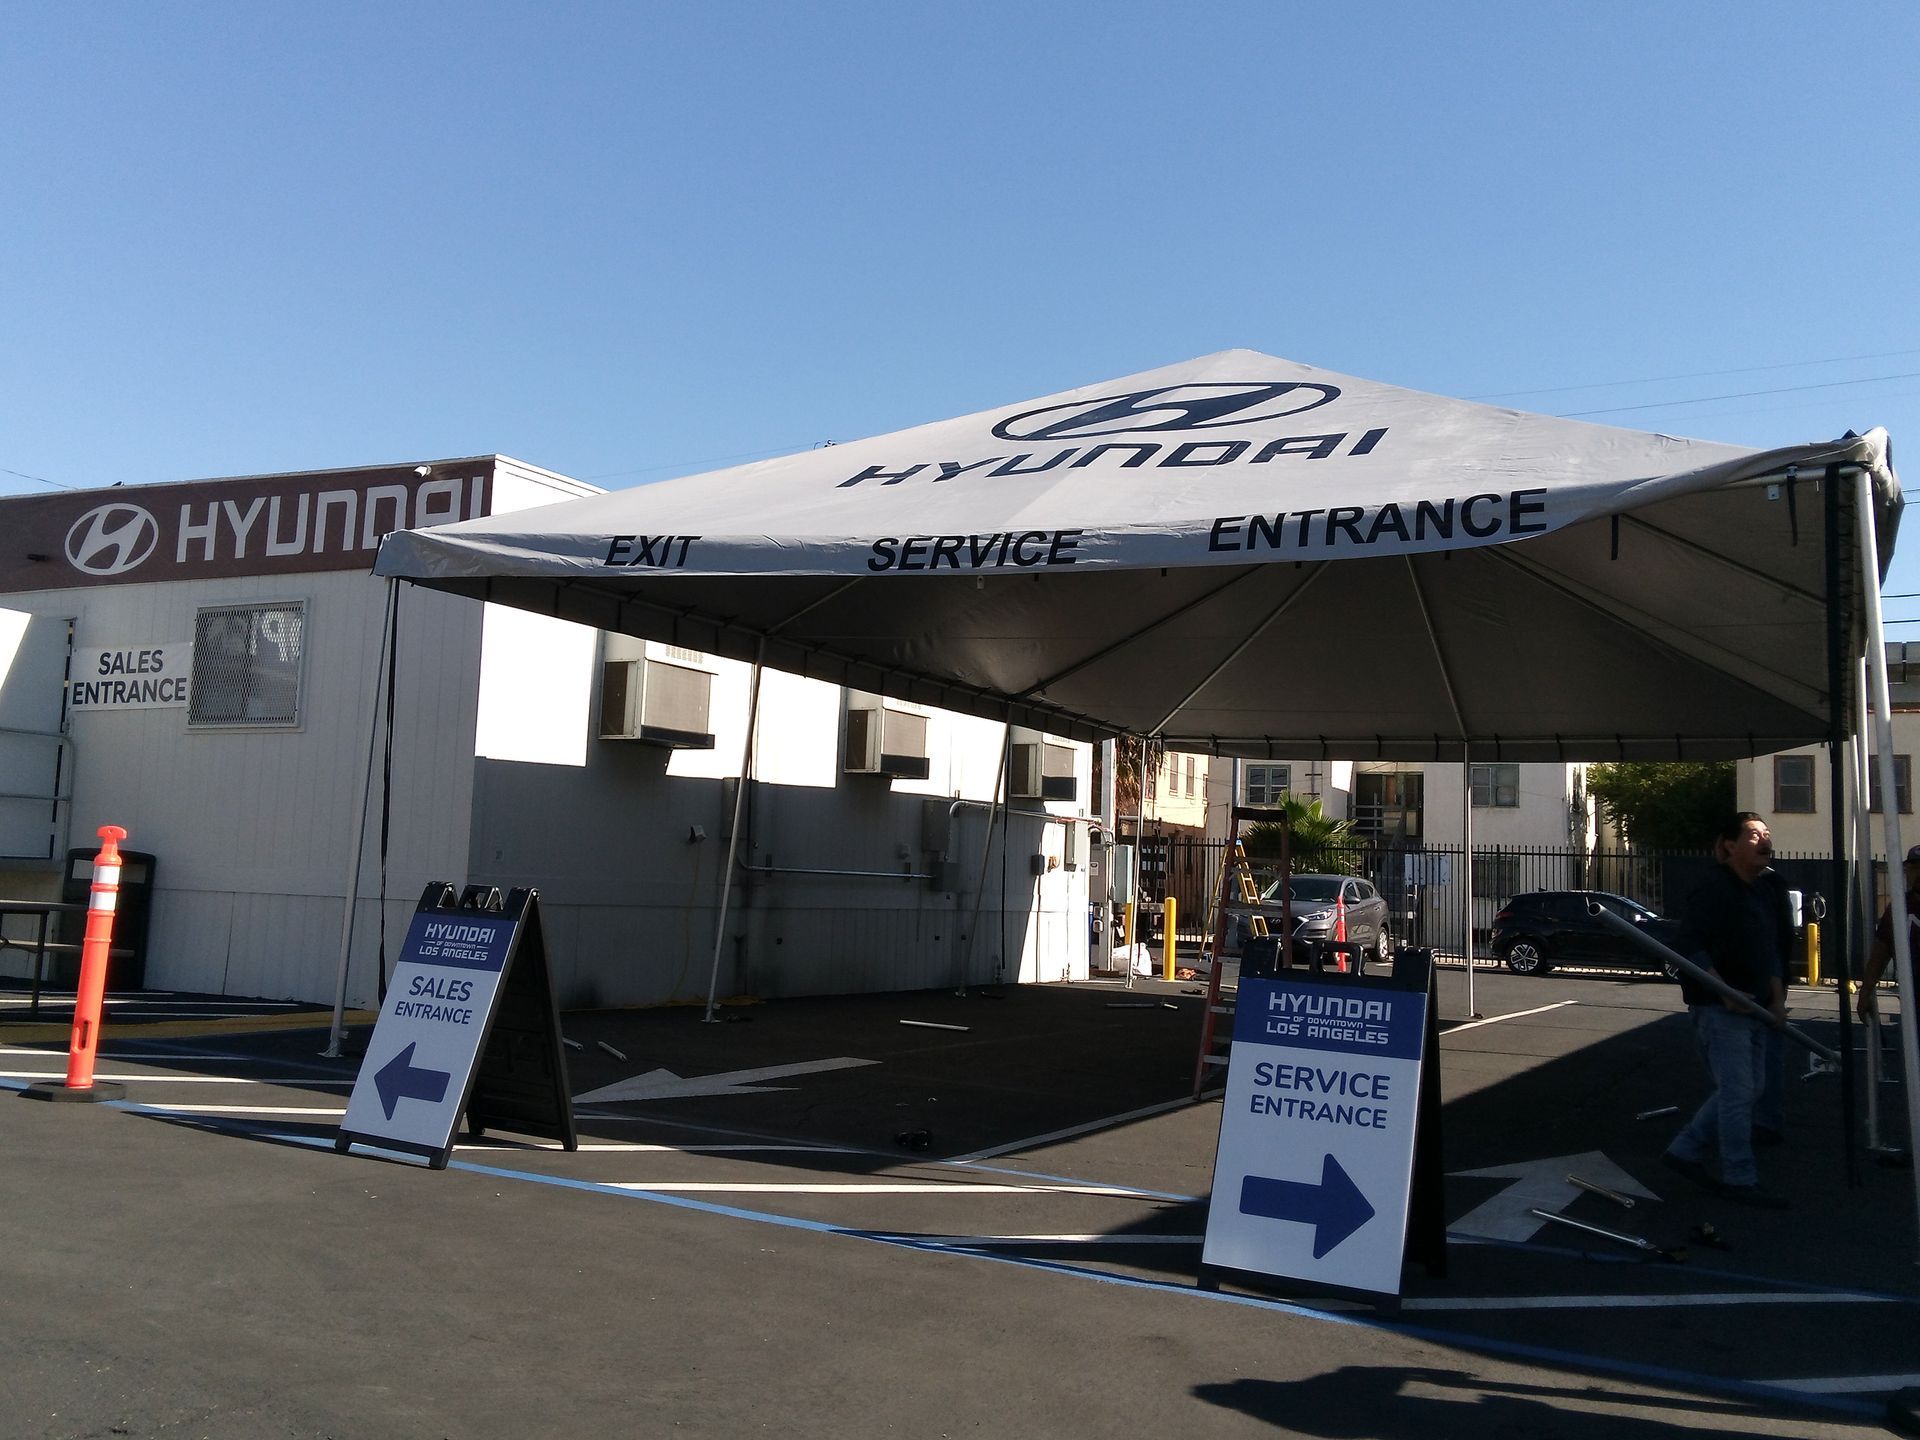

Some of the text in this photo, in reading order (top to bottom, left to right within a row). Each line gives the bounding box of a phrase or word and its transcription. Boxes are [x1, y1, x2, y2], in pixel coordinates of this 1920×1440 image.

[835, 427, 1390, 488] HYUNDAI
[176, 476, 485, 563] HYUNDAI
[604, 487, 1549, 571] EXIT SERVICE ENTRANCE
[97, 648, 164, 677] SALES
[72, 677, 187, 706] ENTRANCE
[425, 923, 496, 943] HYUNDAI
[444, 941, 476, 950] DOWNTOWN
[419, 945, 488, 961] LOS ANGELES
[408, 976, 473, 1001] SALES
[395, 1001, 472, 1024] ENTRANCE
[1268, 991, 1392, 1022] HYUNDAI
[1266, 1021, 1389, 1045] LOS ANGELES
[1293, 1015, 1364, 1029] OF DOWNTOWN
[1253, 1062, 1391, 1100] SERVICE
[1250, 1094, 1388, 1129] ENTRANCE
